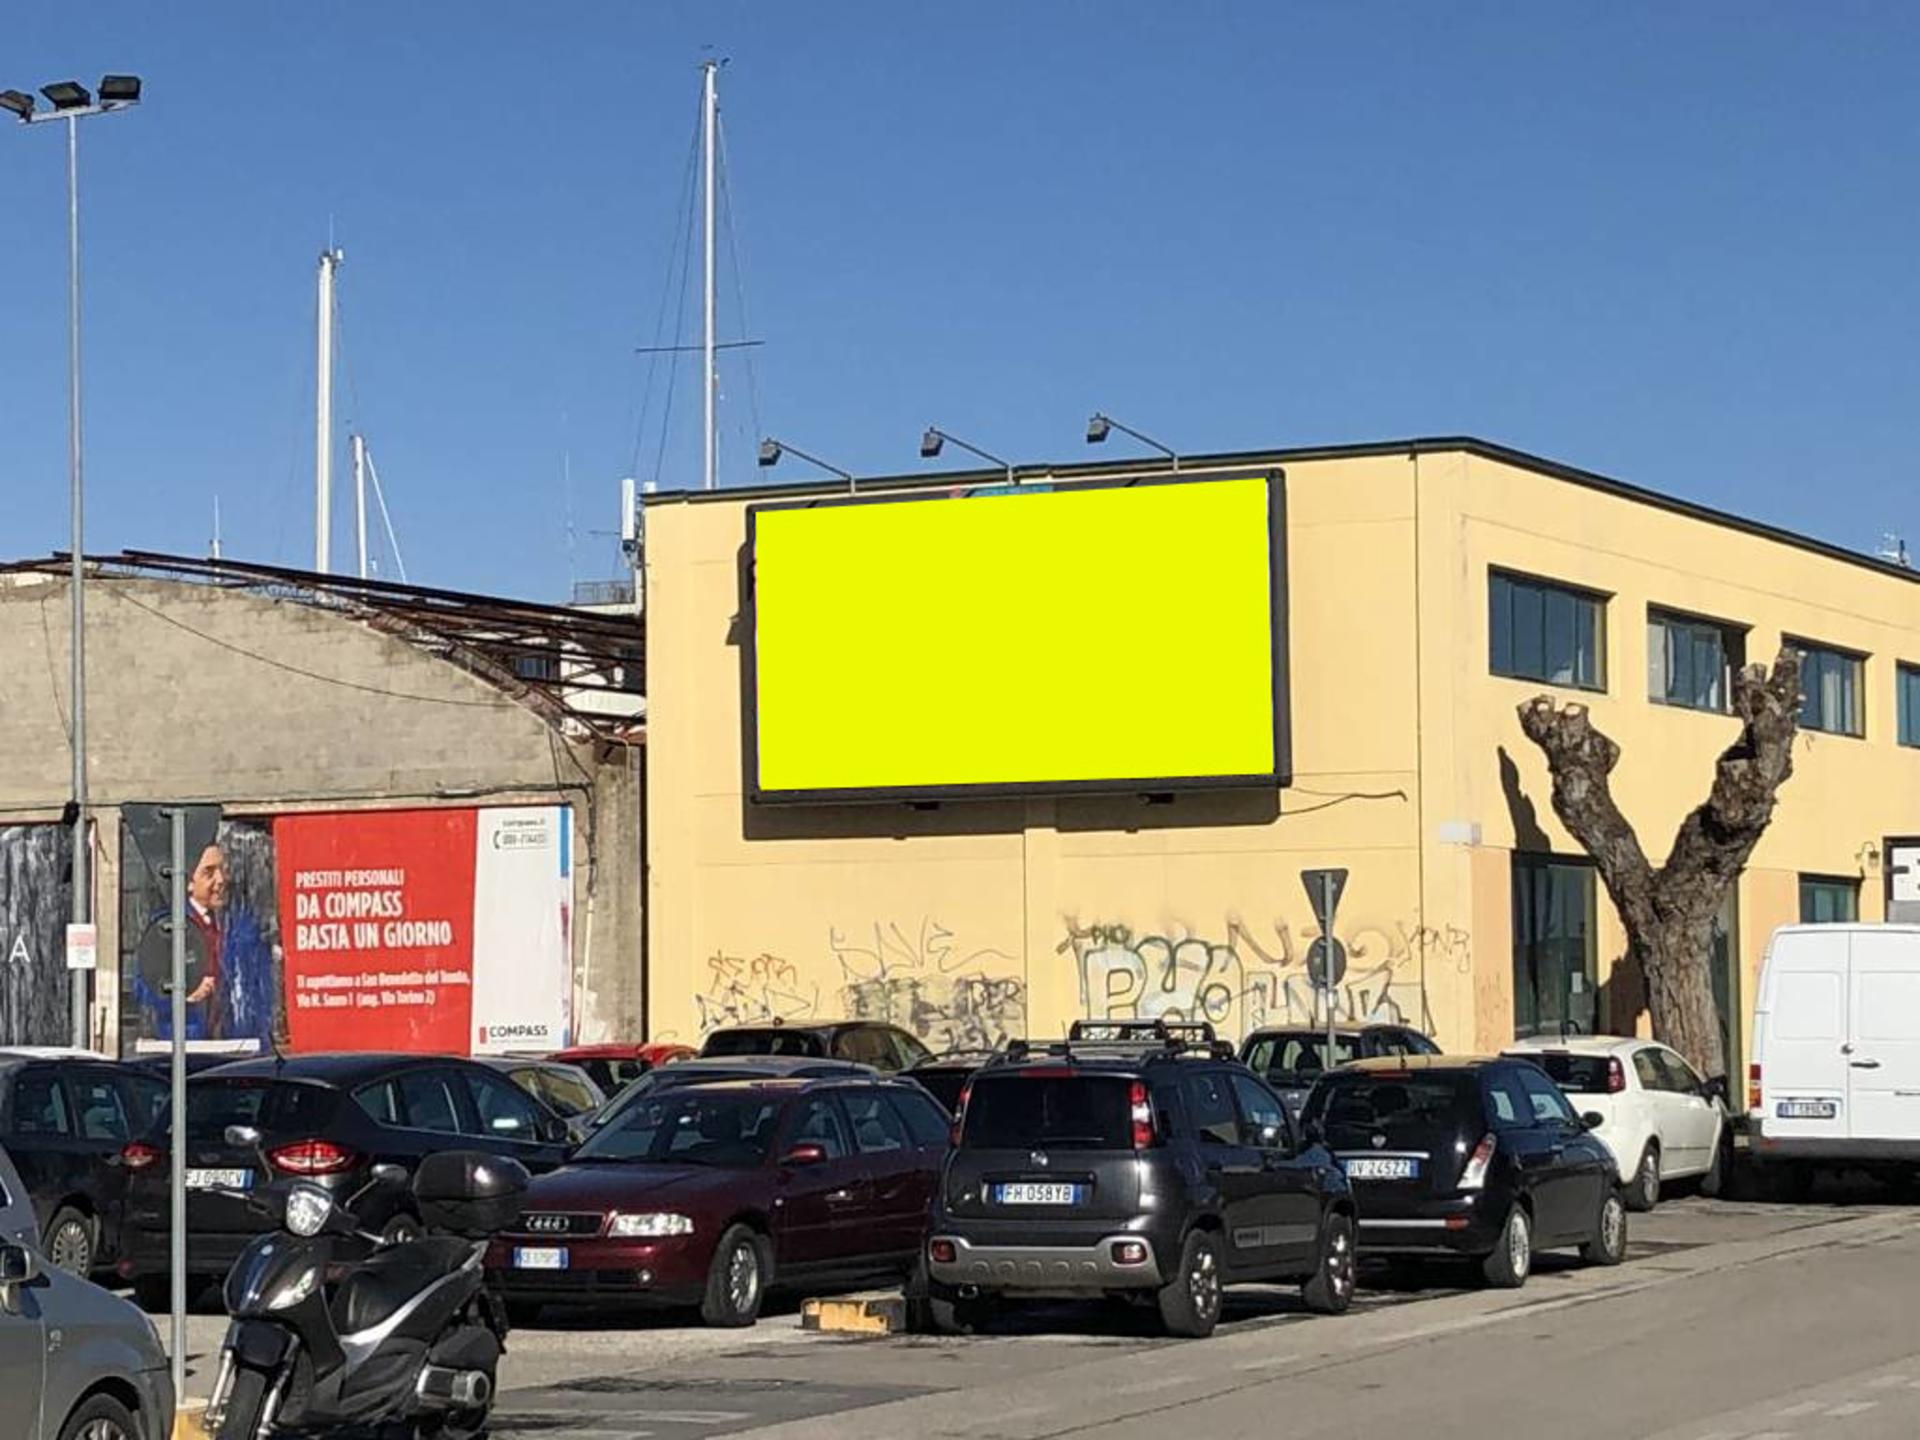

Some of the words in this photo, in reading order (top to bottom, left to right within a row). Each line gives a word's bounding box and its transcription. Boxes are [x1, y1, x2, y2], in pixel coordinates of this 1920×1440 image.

[296, 870, 342, 888] PRESTITI
[344, 869, 405, 887] PERSONALI
[296, 893, 321, 919] DA
[325, 891, 403, 918] COMPASS
[8, 934, 31, 963] A
[296, 923, 350, 950] BASTA
[353, 922, 380, 948] UN
[384, 920, 452, 947] GIORNO
[489, 1024, 548, 1038] COMPASS
